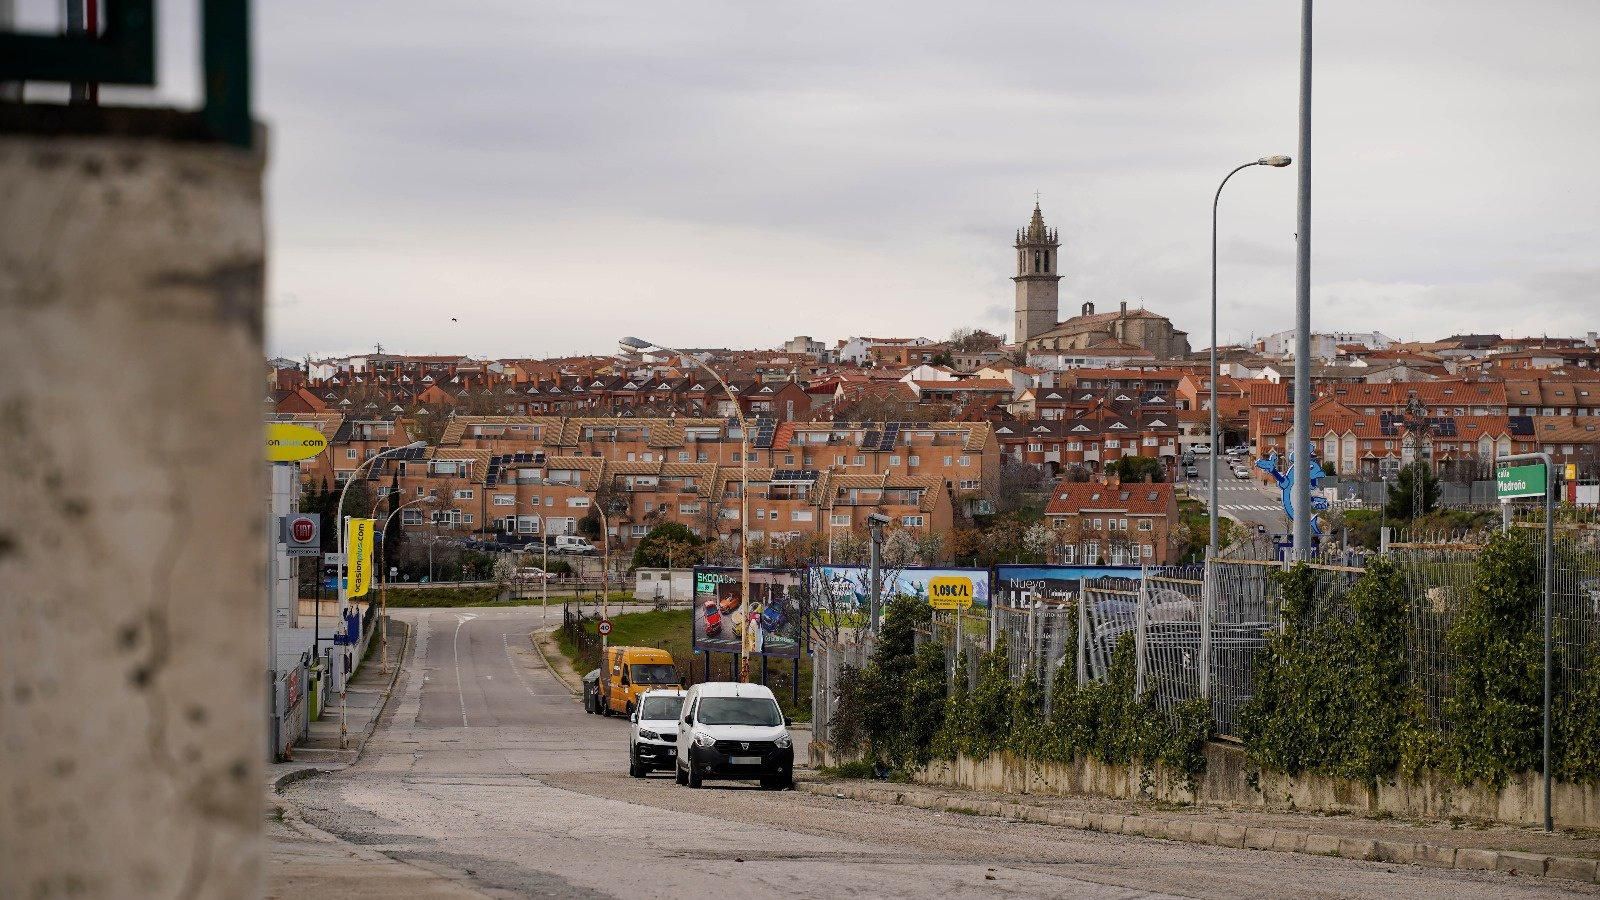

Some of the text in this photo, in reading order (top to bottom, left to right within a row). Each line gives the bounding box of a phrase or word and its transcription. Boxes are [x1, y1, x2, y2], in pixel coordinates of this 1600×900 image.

[1498, 480, 1526, 491] Madroño
[295, 524, 311, 537] FIAT
[354, 523, 365, 593] ocasionplus.com
[1010, 577, 1046, 589] Nuevo
